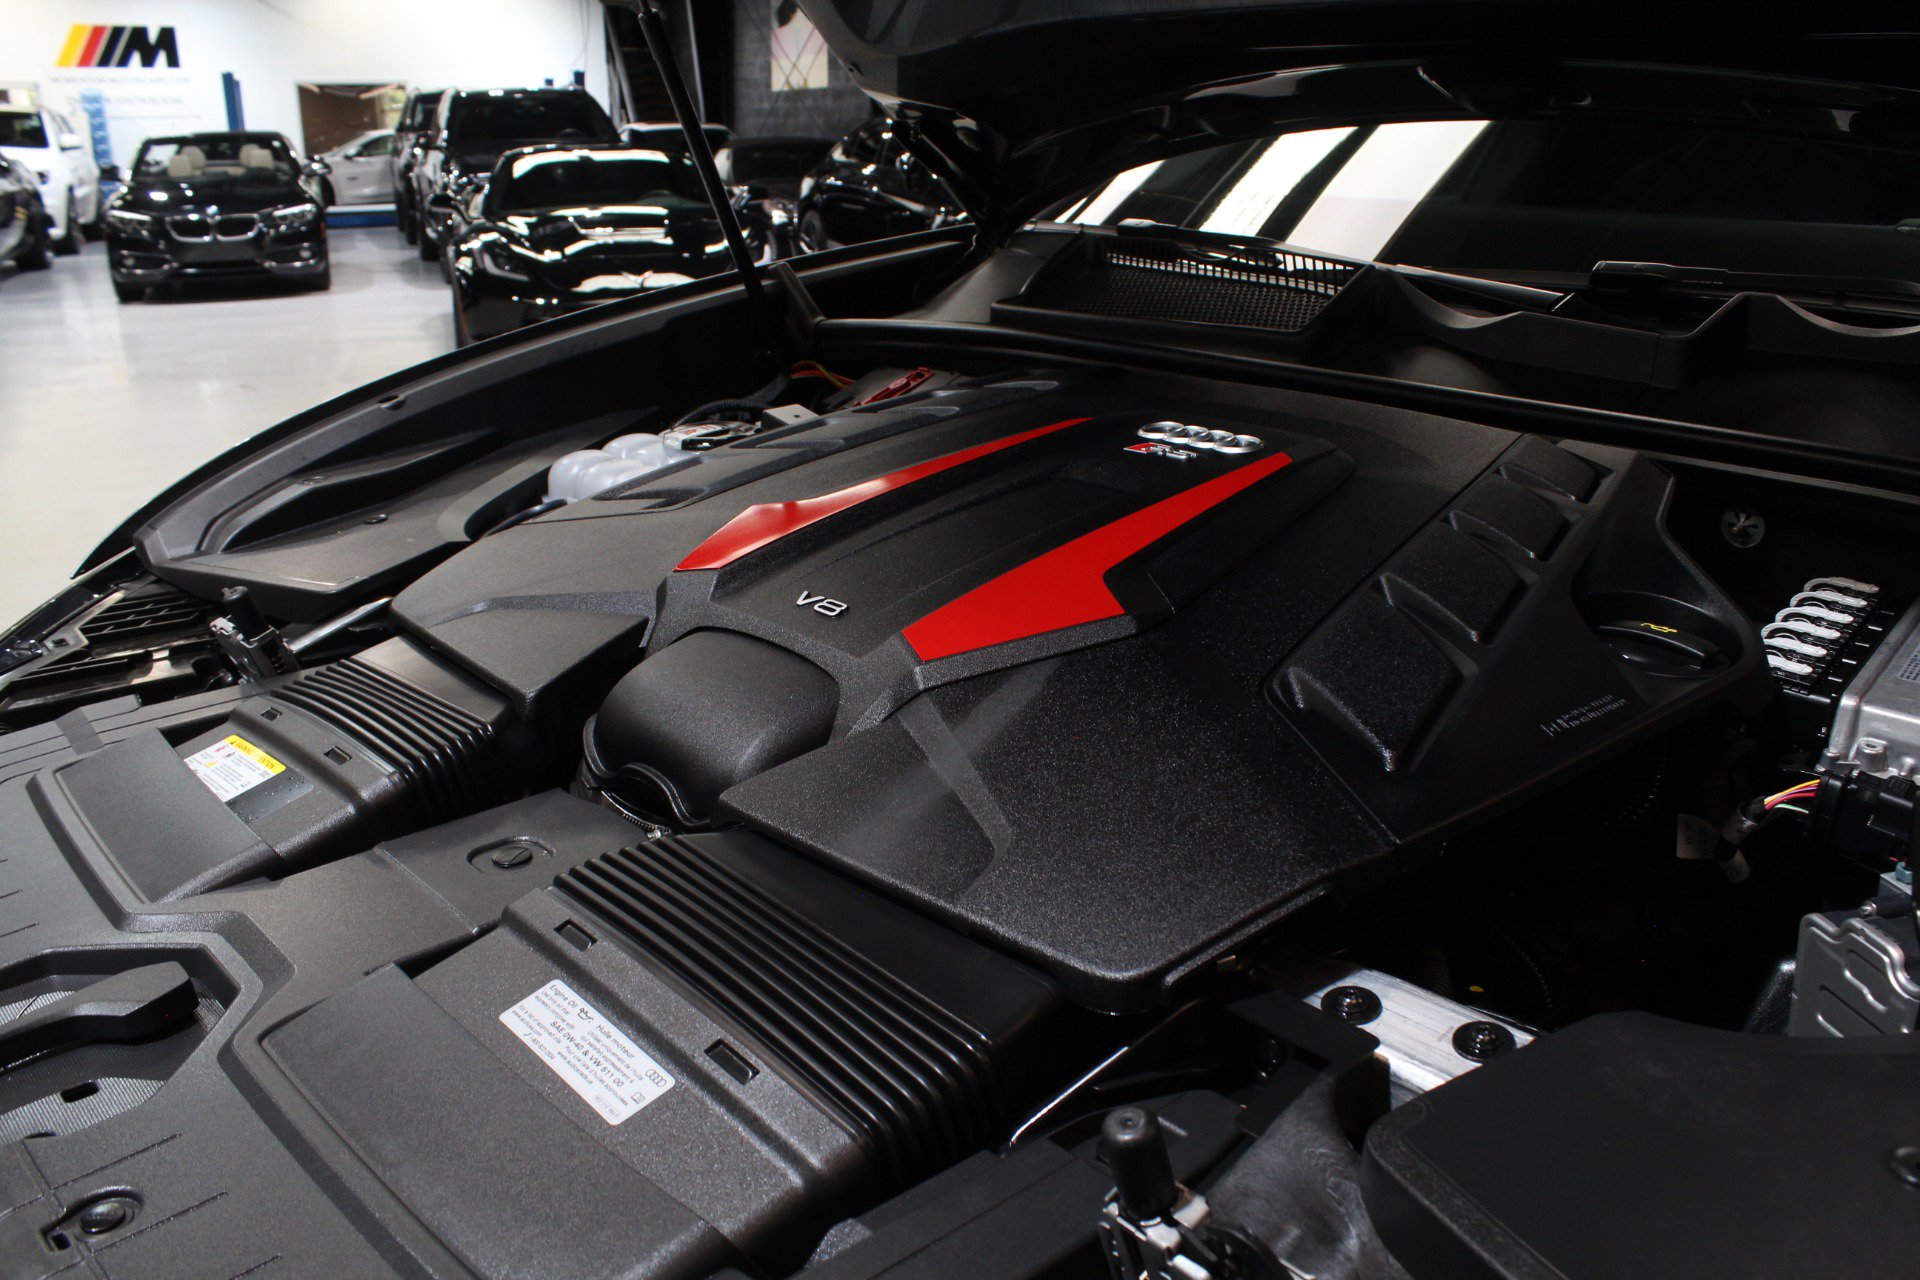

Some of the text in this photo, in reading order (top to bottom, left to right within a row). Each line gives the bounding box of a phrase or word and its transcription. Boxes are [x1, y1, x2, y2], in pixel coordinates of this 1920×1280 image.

[796, 590, 848, 617] V8
[548, 985, 578, 1008] Engine Oil
[550, 1021, 565, 1033] SAE
[563, 1032, 584, 1051] 0W-40
[581, 1049, 591, 1057] &
[589, 1055, 603, 1067] VW
[613, 1078, 625, 1087] 00
[596, 1025, 636, 1059] Huile moteur
